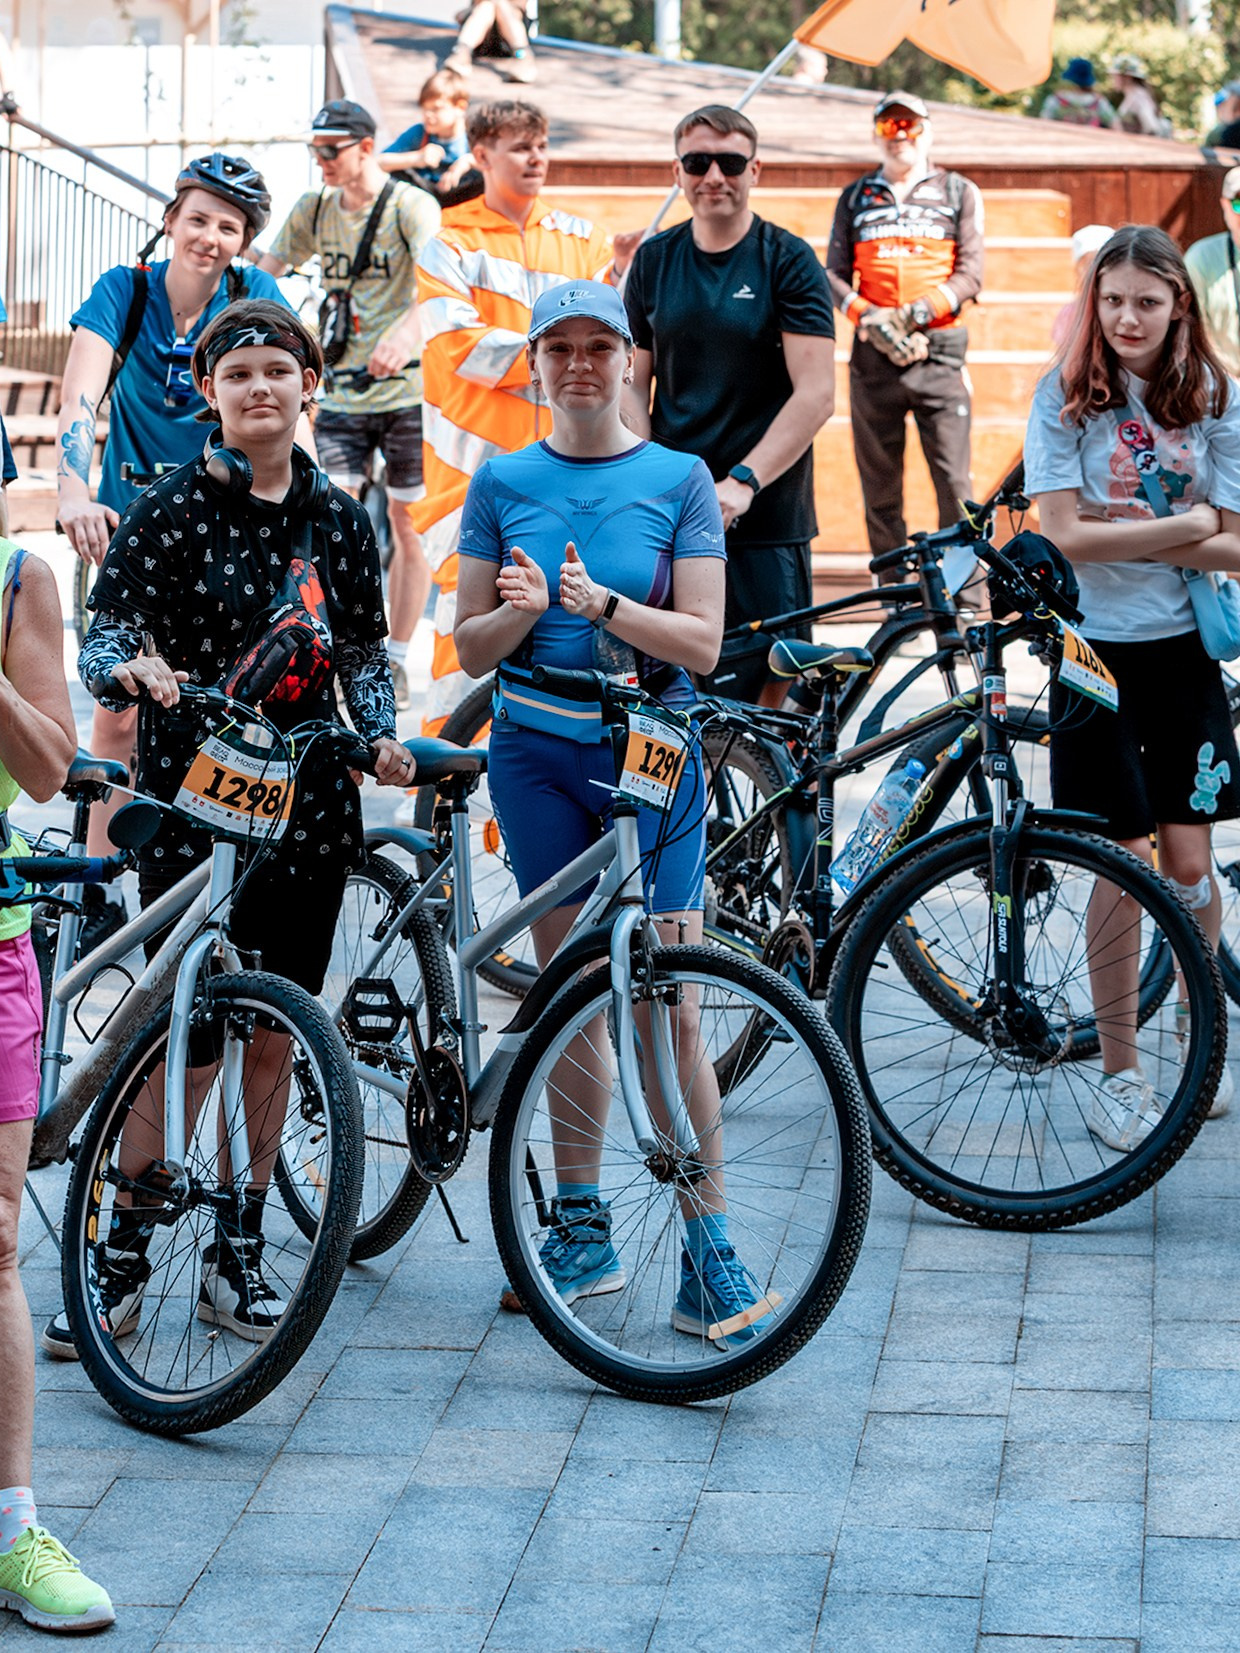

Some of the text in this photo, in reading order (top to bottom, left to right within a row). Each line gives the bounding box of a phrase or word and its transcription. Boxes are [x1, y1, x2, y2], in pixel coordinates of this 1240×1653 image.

[324, 252, 391, 279] 204
[234, 755, 276, 775] Массоый
[203, 766, 282, 816] 1298
